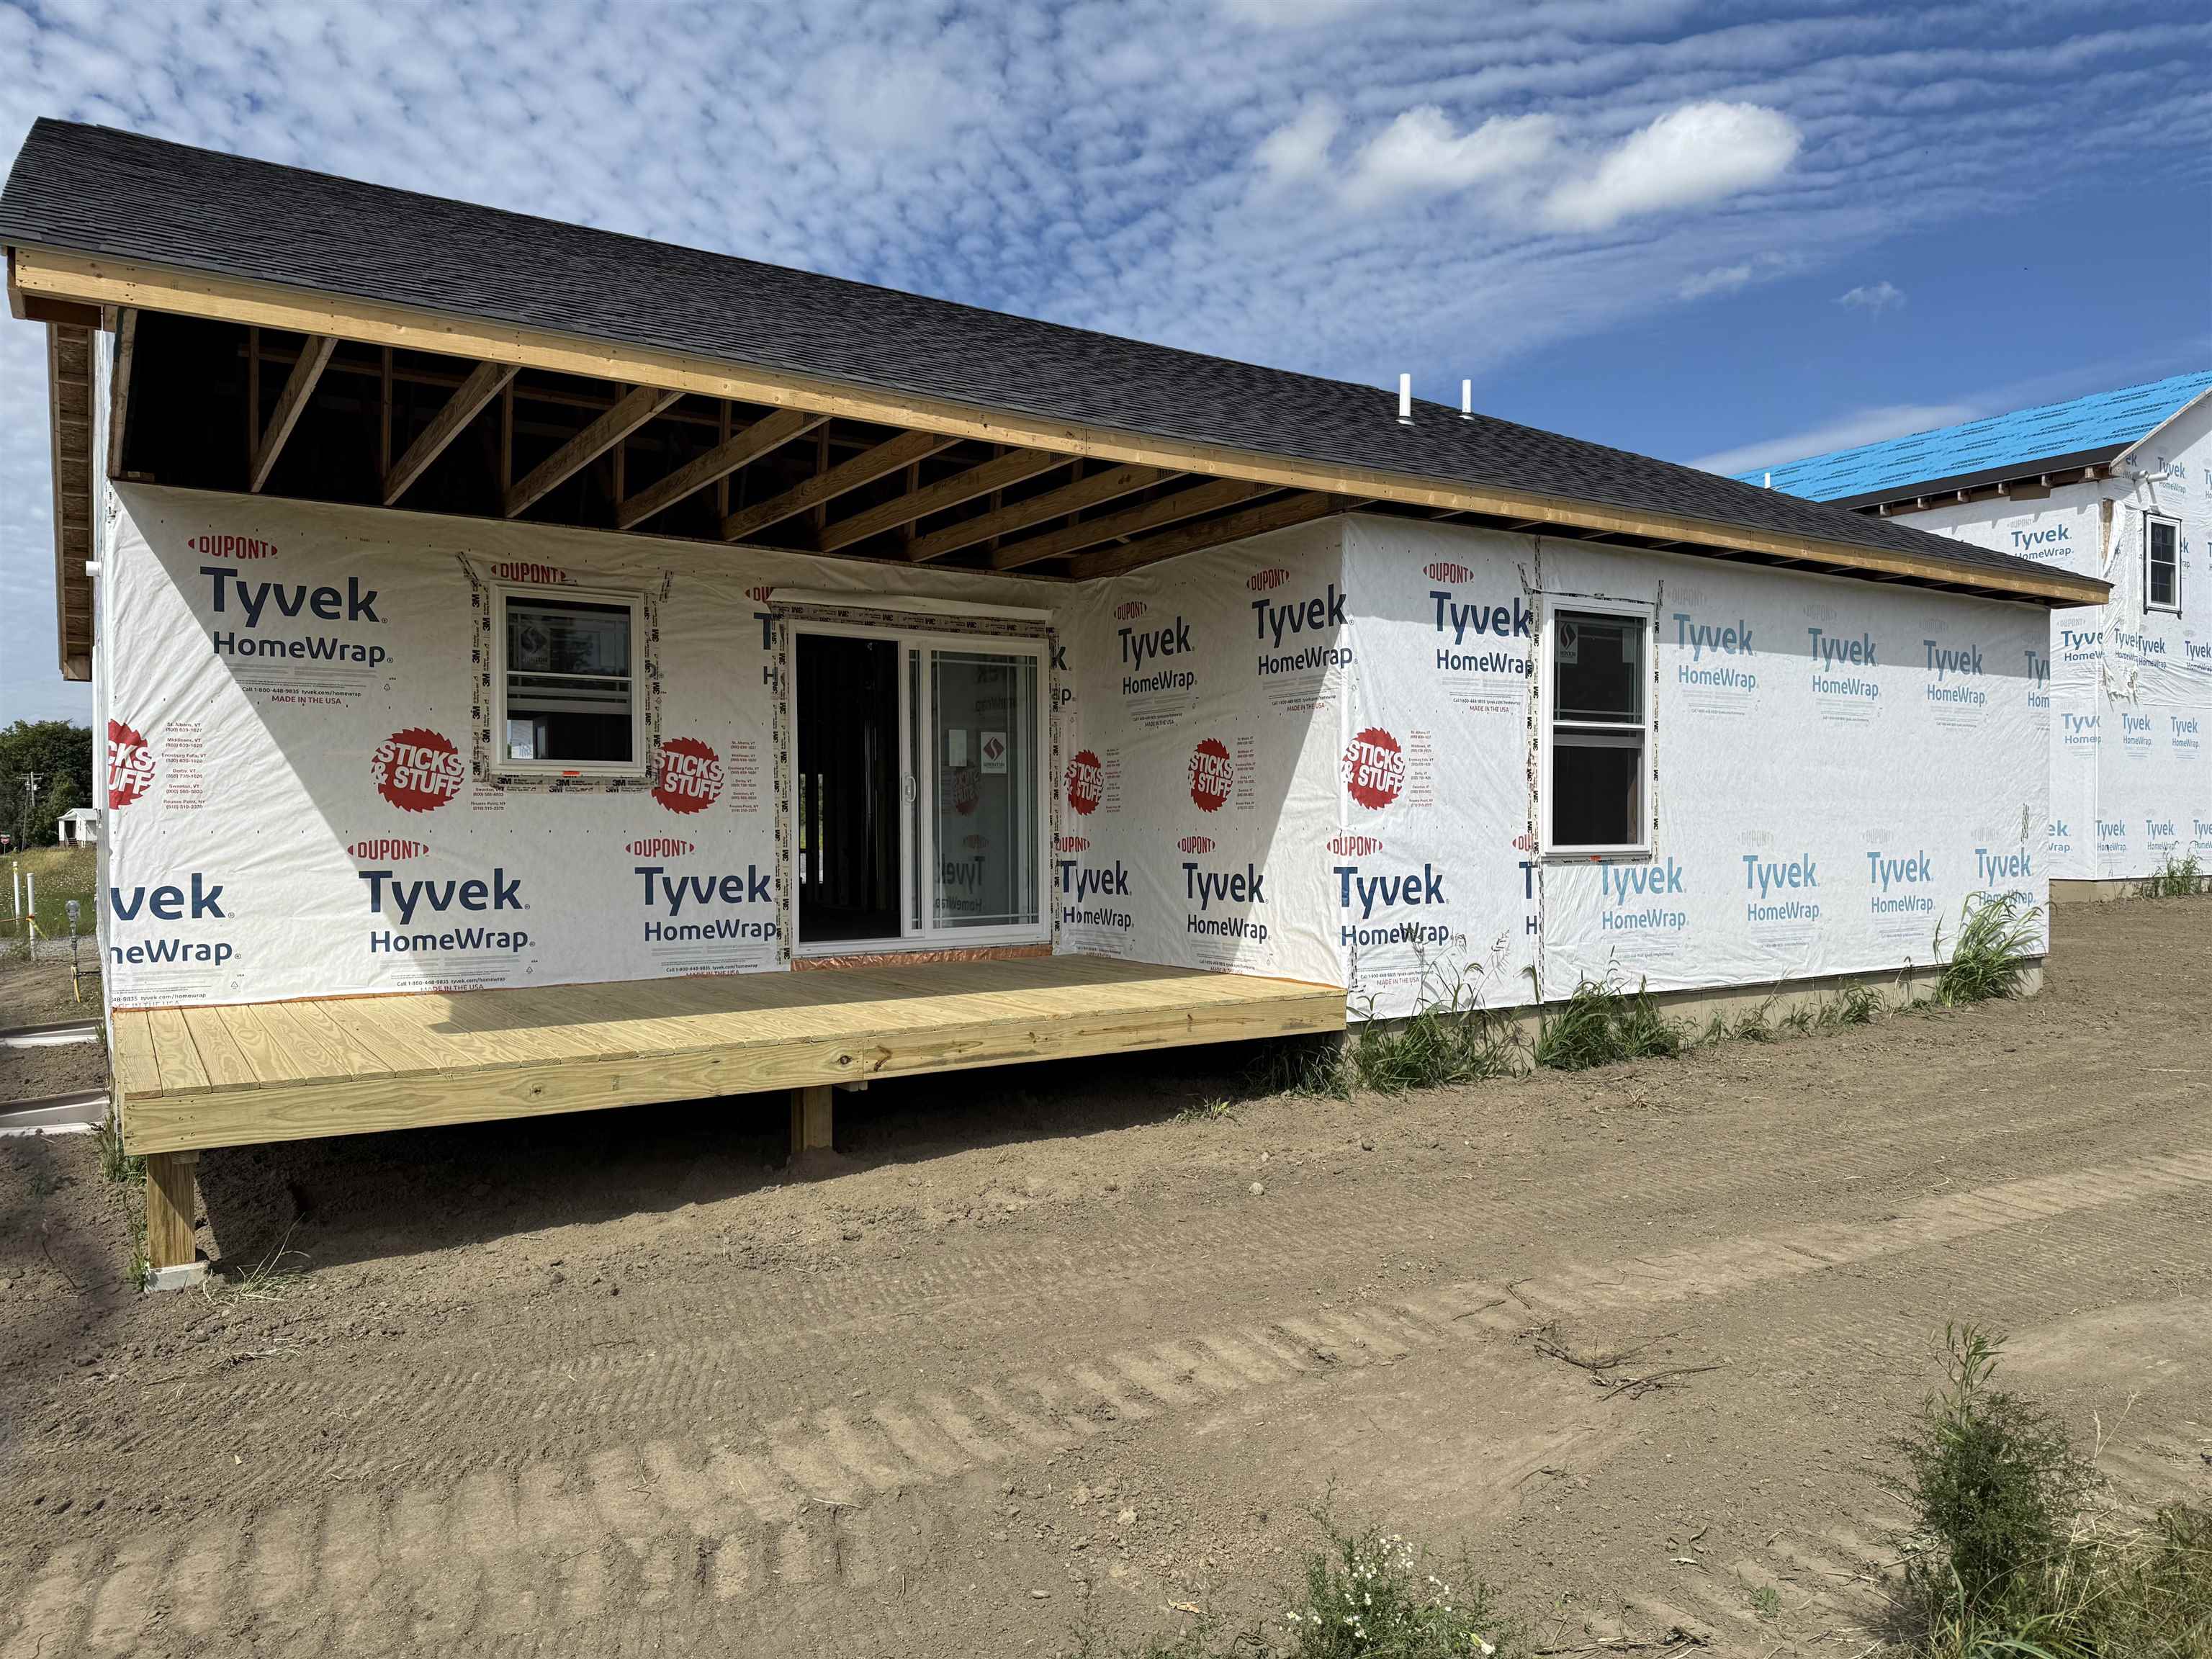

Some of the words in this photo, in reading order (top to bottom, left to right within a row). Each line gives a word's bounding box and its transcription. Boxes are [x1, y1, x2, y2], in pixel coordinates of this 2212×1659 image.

[199, 535, 269, 559] DUPONT
[2011, 524, 2069, 550] Tyvek
[2014, 548, 2072, 561] HomeWrap
[500, 562, 558, 583] DUPONT
[1251, 569, 1285, 590] DUPONT
[1429, 563, 1469, 583] DUPONT
[200, 566, 380, 628] Tyvek
[472, 594, 480, 608] 3M
[1118, 601, 1143, 620] DUPONT
[1251, 584, 1348, 648] Tyvek
[1429, 590, 1532, 645] Tyvek
[1529, 612, 1534, 626] 3M
[482, 618, 491, 631] 3M
[1655, 621, 1660, 634] 3M
[652, 629, 660, 643] 3M
[1118, 616, 1191, 671] Tyvek
[1534, 634, 1540, 647] 3M
[1673, 613, 1753, 662] Tyvek
[2139, 636, 2166, 656] Tyvek
[213, 631, 385, 668] HomeWrap
[472, 649, 480, 664] 3M
[778, 653, 786, 666] 3M
[1808, 628, 1876, 672] Tyvek
[1258, 646, 1352, 675] HomeWrap
[1923, 640, 1983, 681] Tyvek
[2139, 657, 2167, 668] HomeWrap
[482, 673, 490, 688] 3M
[1123, 670, 1195, 695] HomeWrap
[1655, 671, 1660, 684] 3M
[1678, 665, 1756, 692] HomeWrap
[652, 682, 660, 696] 3M
[1534, 686, 1539, 699] 3M
[1812, 675, 1879, 701] HomeWrap
[1928, 684, 1986, 708] HomeWrap
[472, 706, 481, 720] 3M
[780, 702, 787, 715] 3M
[1527, 716, 1533, 729] 3M
[1654, 720, 1659, 733] 3M
[2122, 713, 2151, 734] Tyvek
[2170, 716, 2198, 736] Tyvek
[482, 729, 490, 744] 3M
[653, 734, 661, 748] 3M
[773, 731, 778, 744] 3M
[1533, 738, 1539, 752] 3M
[2123, 736, 2152, 745] HomeWrap
[2172, 738, 2198, 748] HomeWrap
[377, 741, 462, 776] STICKS
[781, 751, 788, 764] 3M
[1053, 745, 1059, 757] 3M
[1347, 739, 1405, 775] STICKS
[473, 762, 481, 776] 3M
[654, 749, 721, 781] STICKS
[1067, 760, 1104, 786] STICKS
[1190, 750, 1233, 780] STICKS
[370, 762, 389, 787] &
[393, 766, 461, 797] STUFF
[1341, 760, 1354, 783] &
[1358, 765, 1404, 794] STUFF
[1654, 769, 1659, 782] 3M
[665, 773, 723, 801] STUFF
[774, 781, 780, 793] 3M
[1054, 789, 1059, 801] 3M
[1077, 781, 1103, 803] STUFF
[1198, 773, 1232, 799] STUFF
[782, 800, 788, 813] 3M
[1534, 791, 1539, 804] 3M
[1527, 821, 1533, 834] 3M
[1654, 818, 1659, 830] 3M
[2096, 820, 2126, 840] Tyvek
[2146, 820, 2175, 840] Tyvek
[775, 830, 781, 842] 3M
[1182, 836, 1212, 854] DUPONT
[1333, 836, 1377, 856] DUPONT
[358, 839, 421, 860] DUPONT
[634, 839, 687, 858] DUPONT
[783, 850, 789, 862] 3M
[1534, 842, 1540, 855] 3M
[1743, 853, 1817, 899] Tyvek
[1867, 850, 1931, 893] Tyvek
[1975, 847, 2032, 887] Tyvek
[634, 865, 773, 916] Tyvek
[776, 878, 781, 891] 3M
[1054, 876, 1061, 888] 3M
[1059, 860, 1128, 903] Tyvek
[1182, 863, 1264, 910] Tyvek
[1600, 856, 1683, 906] Tyvek
[110, 873, 226, 921] vek
[359, 868, 523, 925] Tyvek
[1334, 863, 1445, 920] Tyvek
[783, 898, 790, 911] 3M
[1748, 902, 1820, 922] HomeWrap
[1872, 895, 1933, 914] HomeWrap
[1055, 921, 1061, 932] 3M
[1064, 907, 1132, 932] HomeWrap
[1187, 914, 1267, 944] HomeWrap
[1526, 915, 1537, 935] H
[1602, 909, 1686, 930] HomeWrap
[371, 927, 529, 953] HomeWrap
[644, 920, 776, 942] HomeWrap
[777, 927, 783, 940] 3M
[1341, 922, 1449, 946] HomeWrap
[783, 948, 791, 960] 3M
